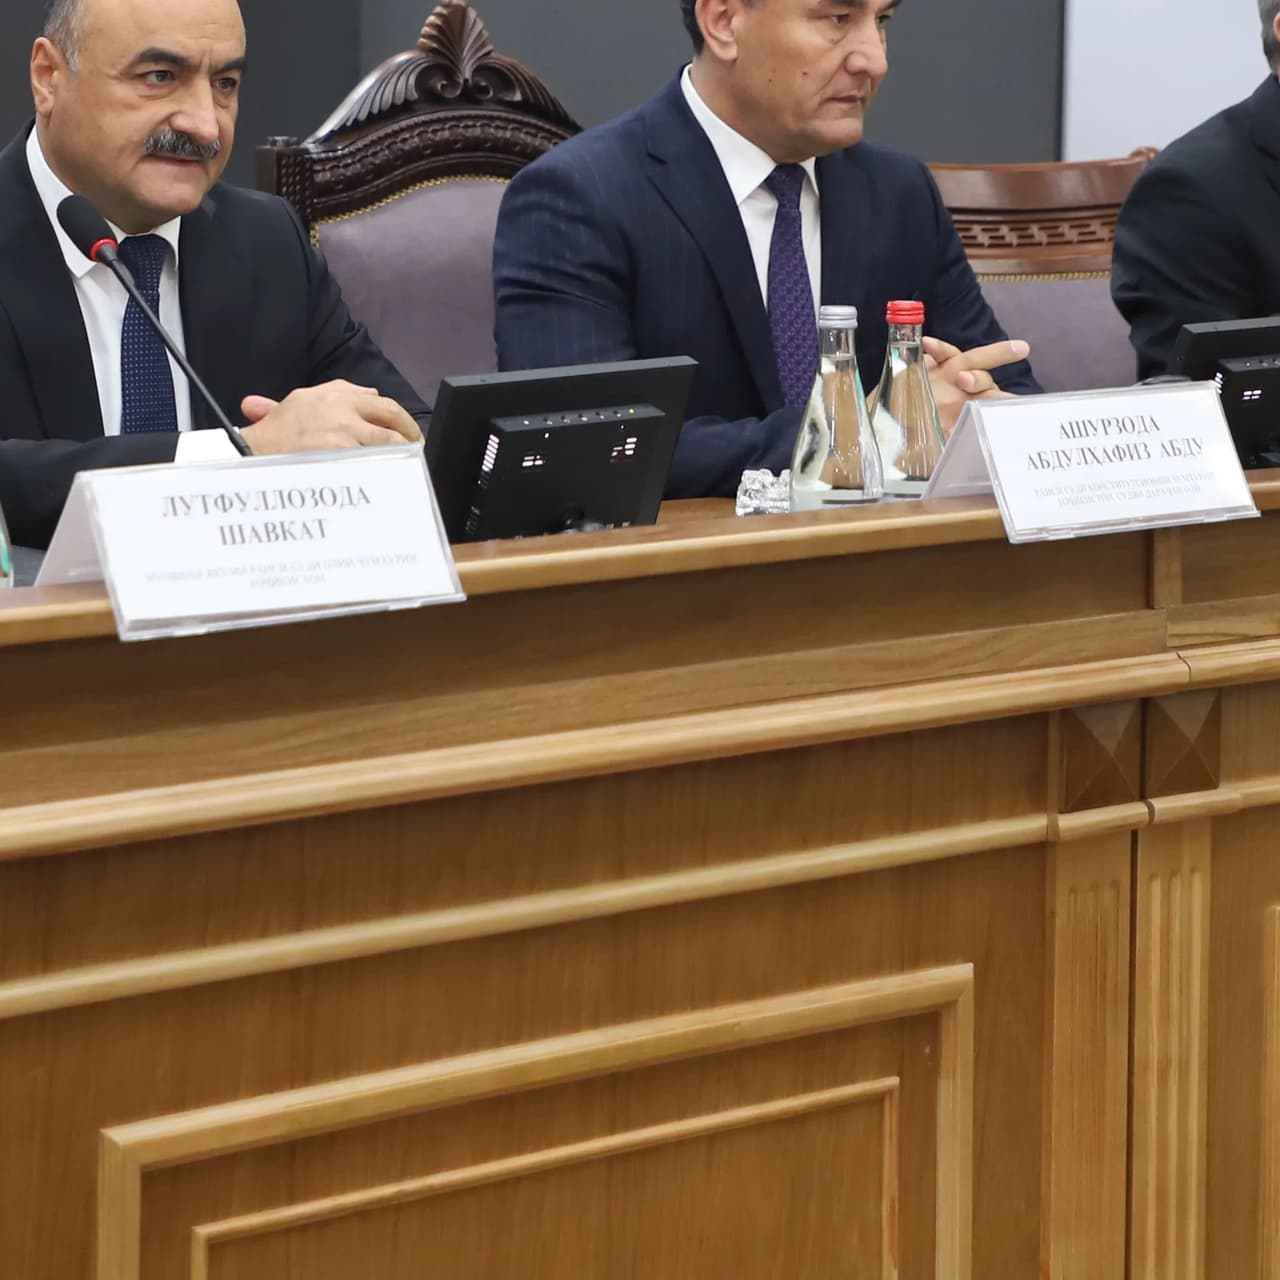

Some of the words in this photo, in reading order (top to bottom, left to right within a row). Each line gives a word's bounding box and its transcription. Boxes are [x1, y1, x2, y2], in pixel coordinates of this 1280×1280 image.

[1059, 415, 1160, 440] АШУРЗОДА
[1160, 436, 1204, 458] АБДУ
[162, 485, 371, 518] ЛУТФУЛЛОЗОДА
[218, 518, 328, 546] ШАВКАТ
